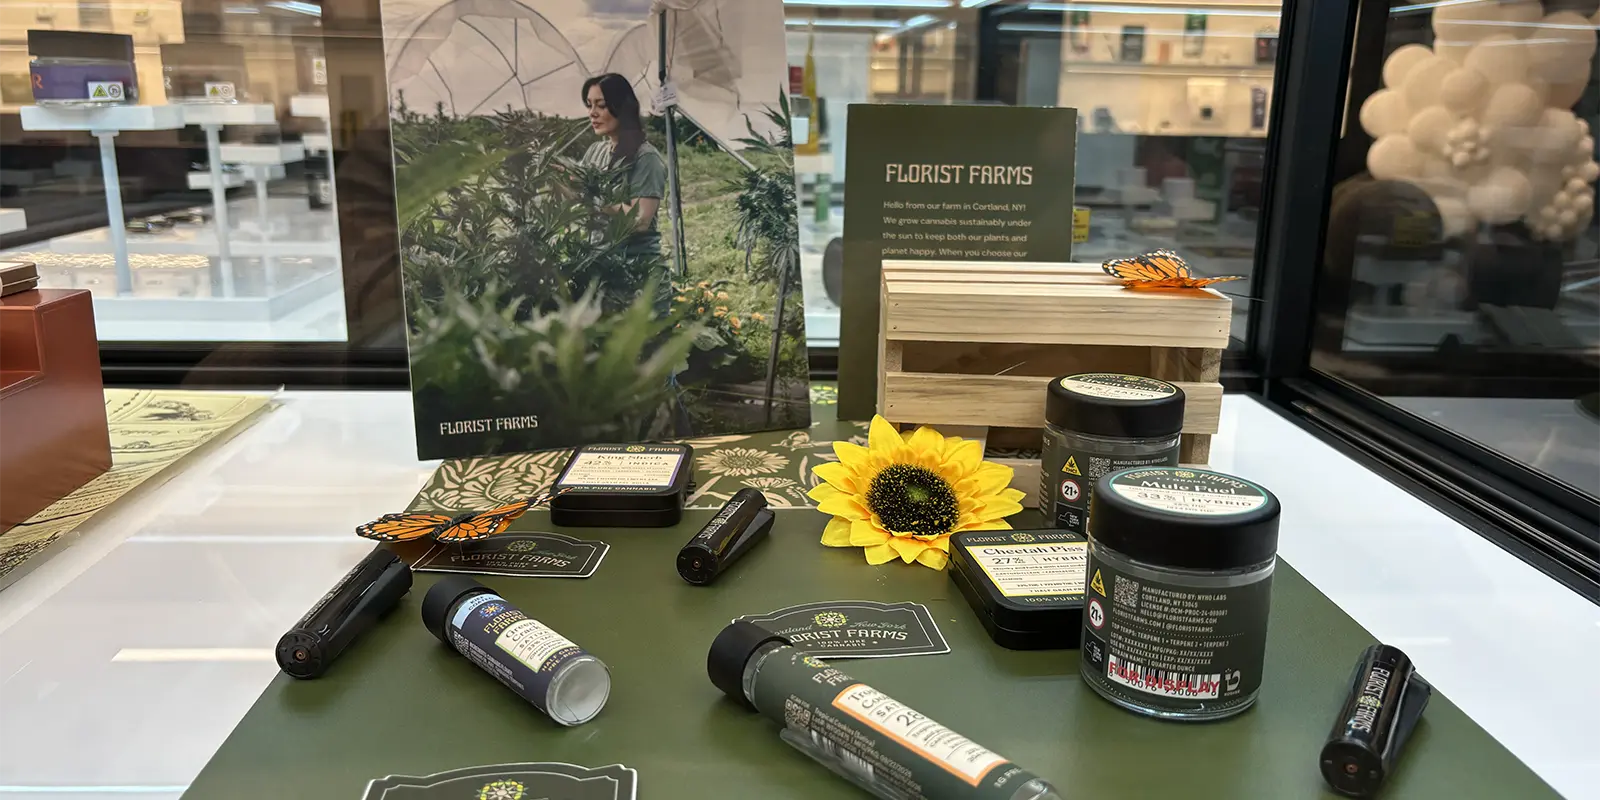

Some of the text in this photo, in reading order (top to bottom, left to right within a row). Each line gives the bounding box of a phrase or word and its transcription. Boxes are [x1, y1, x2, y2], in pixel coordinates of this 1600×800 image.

[886, 164, 1033, 185] FLORIST FARMS
[883, 201, 904, 209] Hello
[905, 202, 925, 210] from
[942, 202, 961, 210] farm
[972, 203, 1010, 212] Cortland,
[920, 218, 957, 226] cannabis
[959, 219, 1006, 228] sustainably
[1007, 219, 1032, 227] under
[925, 233, 946, 242] keep
[947, 233, 967, 241] both
[983, 234, 1009, 242] plants
[881, 247, 908, 256] planet
[909, 248, 938, 257] happy.
[939, 248, 963, 256] When
[982, 249, 1012, 257] choose
[440, 415, 538, 435] FLORIST FARMS
[1064, 485, 1078, 496] 21+
[1141, 480, 1189, 490] Mule
[1194, 485, 1236, 494] Fuel
[1191, 498, 1252, 506] HYBRID
[983, 545, 1084, 555] Cheetah Piss
[450, 553, 520, 562] FLORIST
[520, 554, 571, 568] FARMS
[1141, 593, 1172, 606] CORTLAND,
[1142, 585, 1186, 600] MANUFACTURED
[1187, 593, 1197, 601] BY:
[1091, 605, 1103, 621] 21+
[1140, 601, 1163, 612] LICENSE
[1113, 607, 1213, 633] FLORISTFARMS.COM @FLORISTFARMS
[1140, 609, 1218, 624] HELLO@FLORISTFARMS.COM
[505, 621, 536, 638] Green
[512, 625, 541, 642] Crack
[774, 624, 813, 636] ortland
[790, 629, 908, 643] ORIST FARMS
[1112, 622, 1120, 630] TOP
[1120, 626, 1137, 637] TERPS:
[1137, 632, 1161, 643] TERPENE
[1170, 639, 1194, 648] TERPENE
[519, 630, 549, 649] SATIVA
[1109, 639, 1118, 647] USE
[1163, 655, 1176, 663] EXP:
[541, 655, 557, 672] HALF
[1150, 660, 1177, 670] QUARTER
[1176, 664, 1196, 672] OUNCE
[1109, 661, 1220, 693] FOR DISPLAY
[1364, 666, 1390, 702] FLORIST
[847, 689, 878, 701] Trop
[876, 702, 900, 717] SAT
[1352, 703, 1377, 734] FARMS
